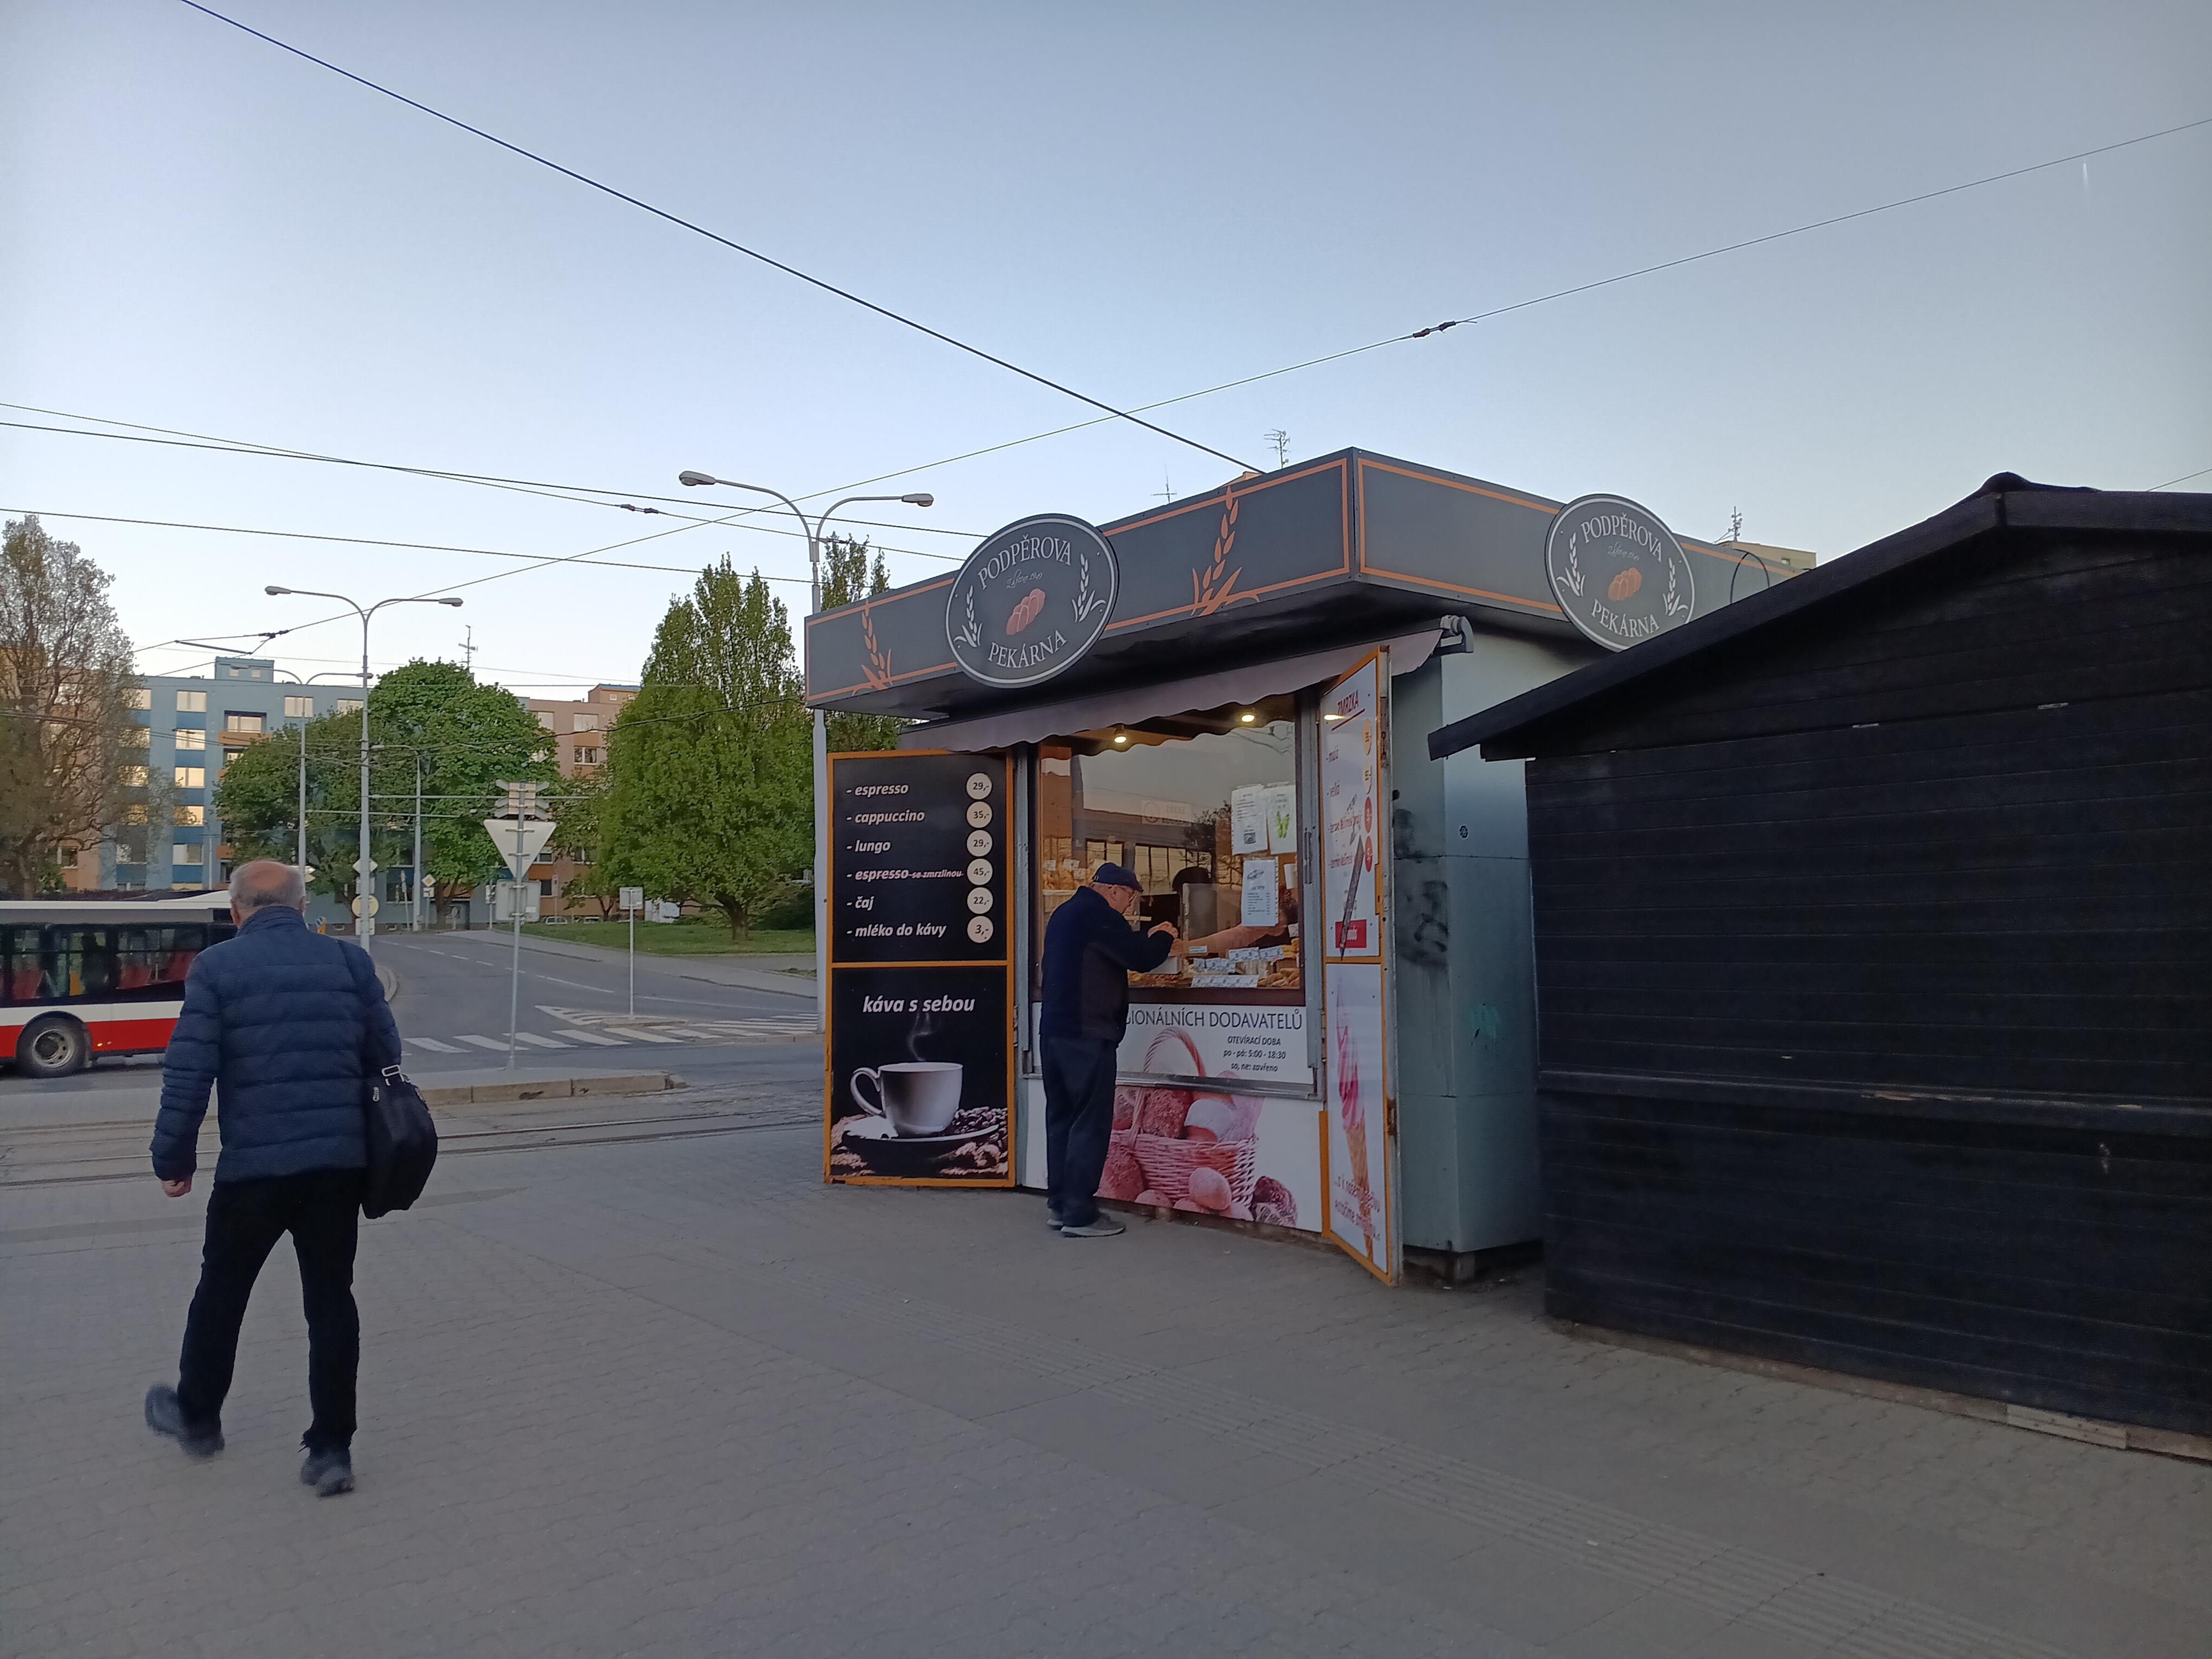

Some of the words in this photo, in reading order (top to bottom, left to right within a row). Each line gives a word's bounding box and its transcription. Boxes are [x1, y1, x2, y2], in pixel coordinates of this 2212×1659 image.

[1580, 512, 1662, 563] PODPĚROVA
[977, 534, 1071, 590] PODPĚROVA
[1591, 598, 1660, 638] PEKÁRNA
[988, 630, 1067, 668] PEKÁRNA
[854, 784, 909, 797] espresso
[854, 810, 925, 825] cappuccino
[854, 839, 891, 854] lungo
[855, 869, 909, 882] espresso
[855, 896, 874, 910] čaj
[855, 924, 893, 937] mléko
[896, 924, 913, 936] do
[916, 923, 947, 938] kávy
[863, 995, 905, 1013] káva
[908, 999, 918, 1012] s
[922, 994, 975, 1012] sebou
[1209, 1008, 1302, 1030] DODAVATELŮ
[1228, 1034, 1262, 1045] OTEVÍRACÍ
